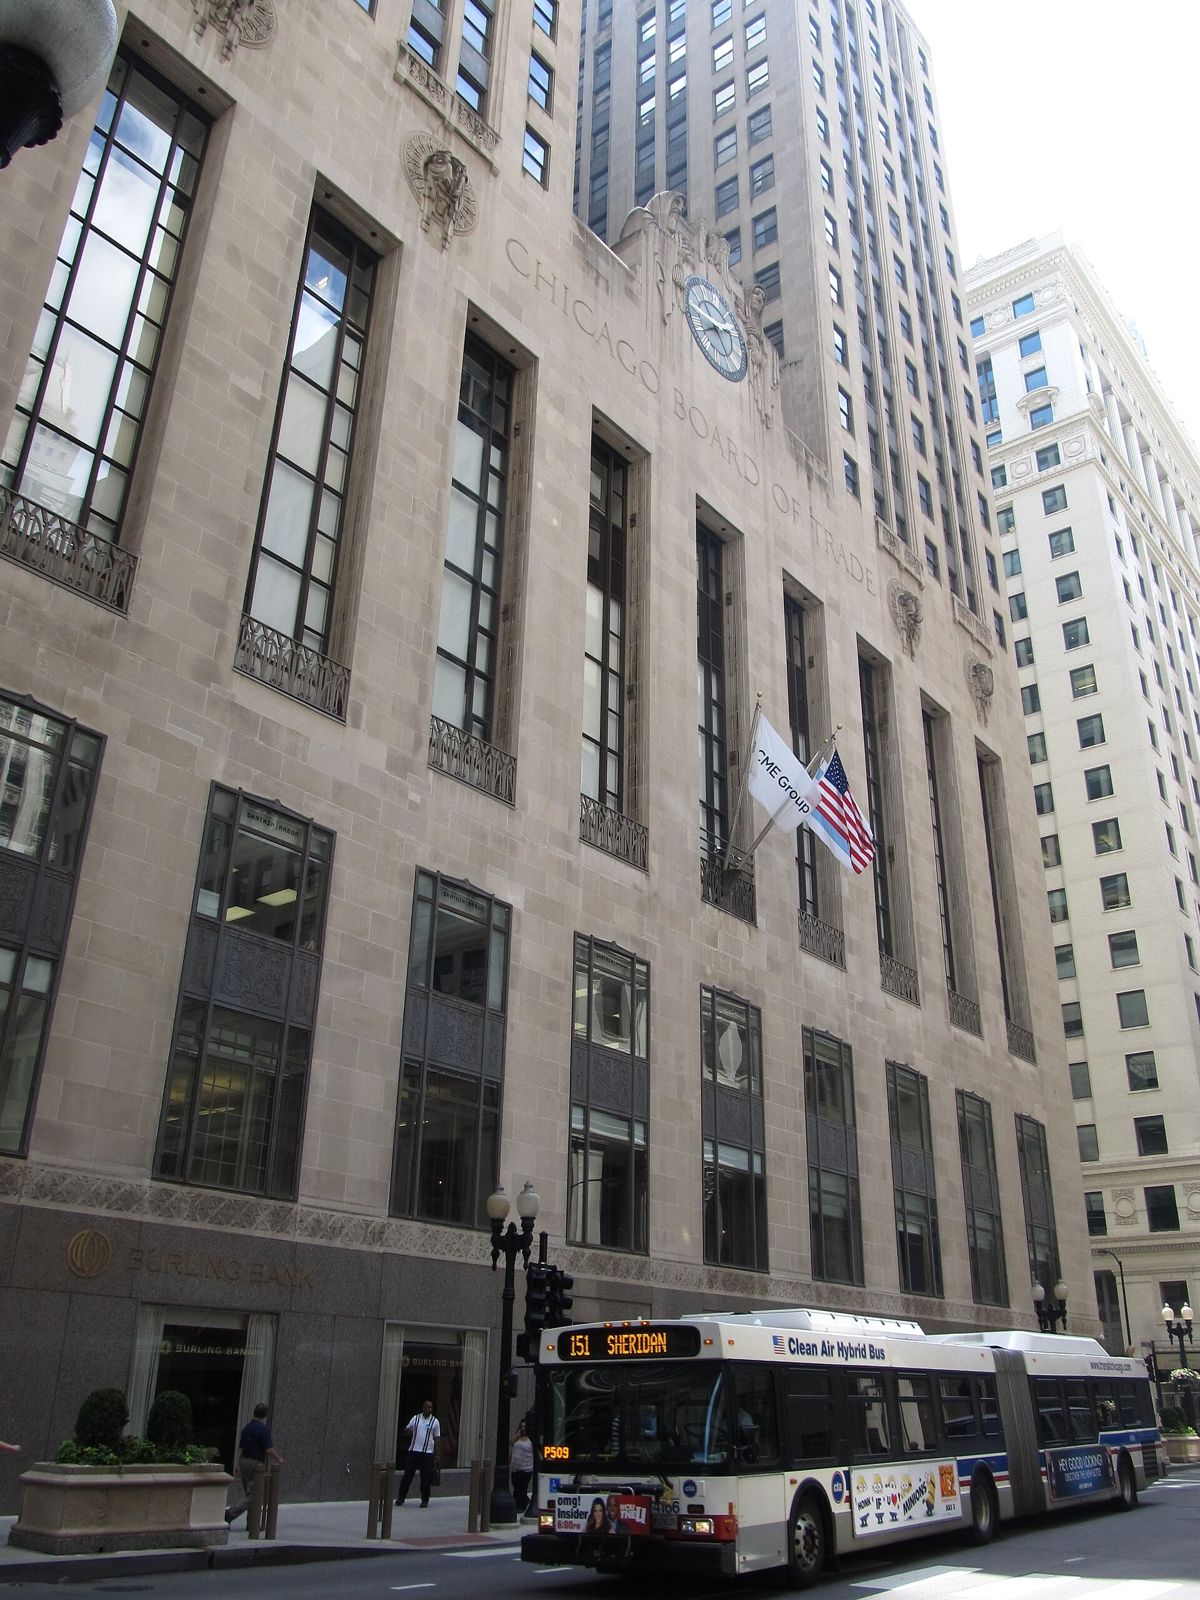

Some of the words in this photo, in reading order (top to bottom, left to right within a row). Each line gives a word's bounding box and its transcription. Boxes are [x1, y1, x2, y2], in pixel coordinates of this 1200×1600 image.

[505, 238, 660, 394] CHICAGO
[673, 387, 760, 487] BOARD
[772, 483, 801, 524] OF
[810, 512, 876, 597] TRADE
[778, 776, 810, 814] Group
[128, 1248, 243, 1281] BURLING
[249, 1262, 314, 1289] BANK
[175, 1344, 222, 1355] BURLING
[570, 1335, 590, 1356] 151
[607, 1332, 667, 1355] SHERIDAN
[788, 1337, 818, 1356] Clean
[821, 1340, 835, 1357] Air
[837, 1341, 867, 1361] Hybrid
[868, 1344, 886, 1360] Bus
[412, 1358, 447, 1367] BURLING
[544, 1446, 569, 1459] P509
[557, 1495, 581, 1507] omg!
[903, 1482, 927, 1516] MINIONS
[557, 1508, 589, 1520] Insider
